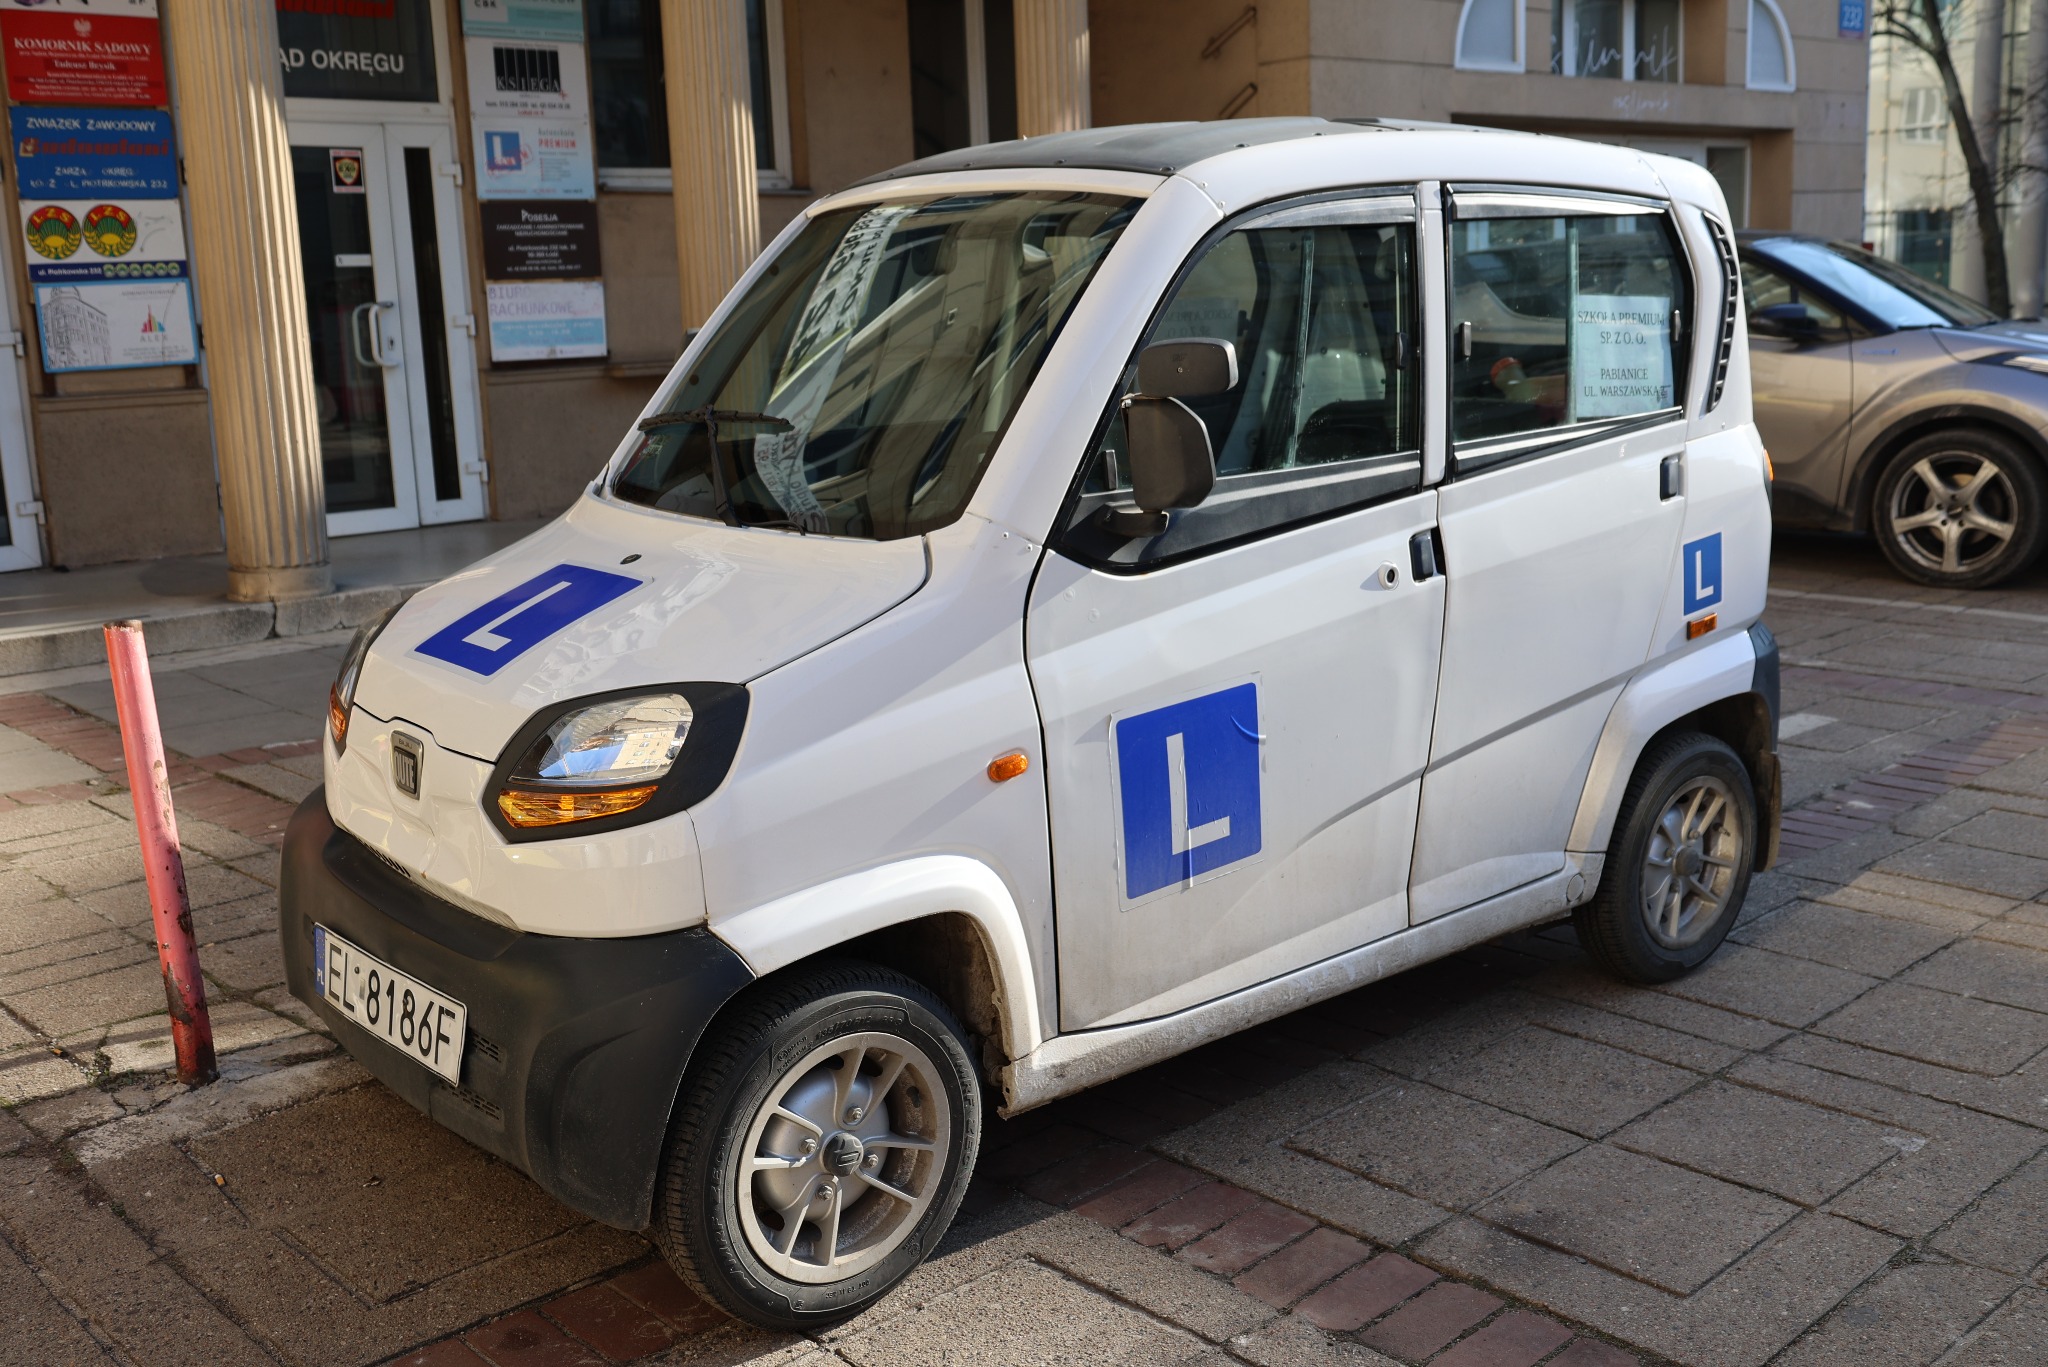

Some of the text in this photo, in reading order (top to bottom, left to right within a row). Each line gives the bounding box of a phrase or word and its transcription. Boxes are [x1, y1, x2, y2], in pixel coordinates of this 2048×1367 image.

[14, 37, 151, 55] KOMORNIK SĄDOWY
[311, 49, 404, 77] OKRĘGU
[26, 117, 157, 132] ZWIĄZEK ZAWODOWY
[489, 301, 573, 317] RACHUNKOWE
[1578, 311, 1665, 326] SZKOŁA PREMIUM
[1600, 331, 1647, 344] SP. Z O. O.
[1600, 368, 1648, 380] PABIANICE
[1584, 386, 1598, 397] UL.
[1696, 550, 1714, 600] L
[462, 580, 572, 652] L
[395, 750, 415, 790] QUTE
[1166, 732, 1230, 856] L
[329, 942, 456, 1065] EL 8186F
